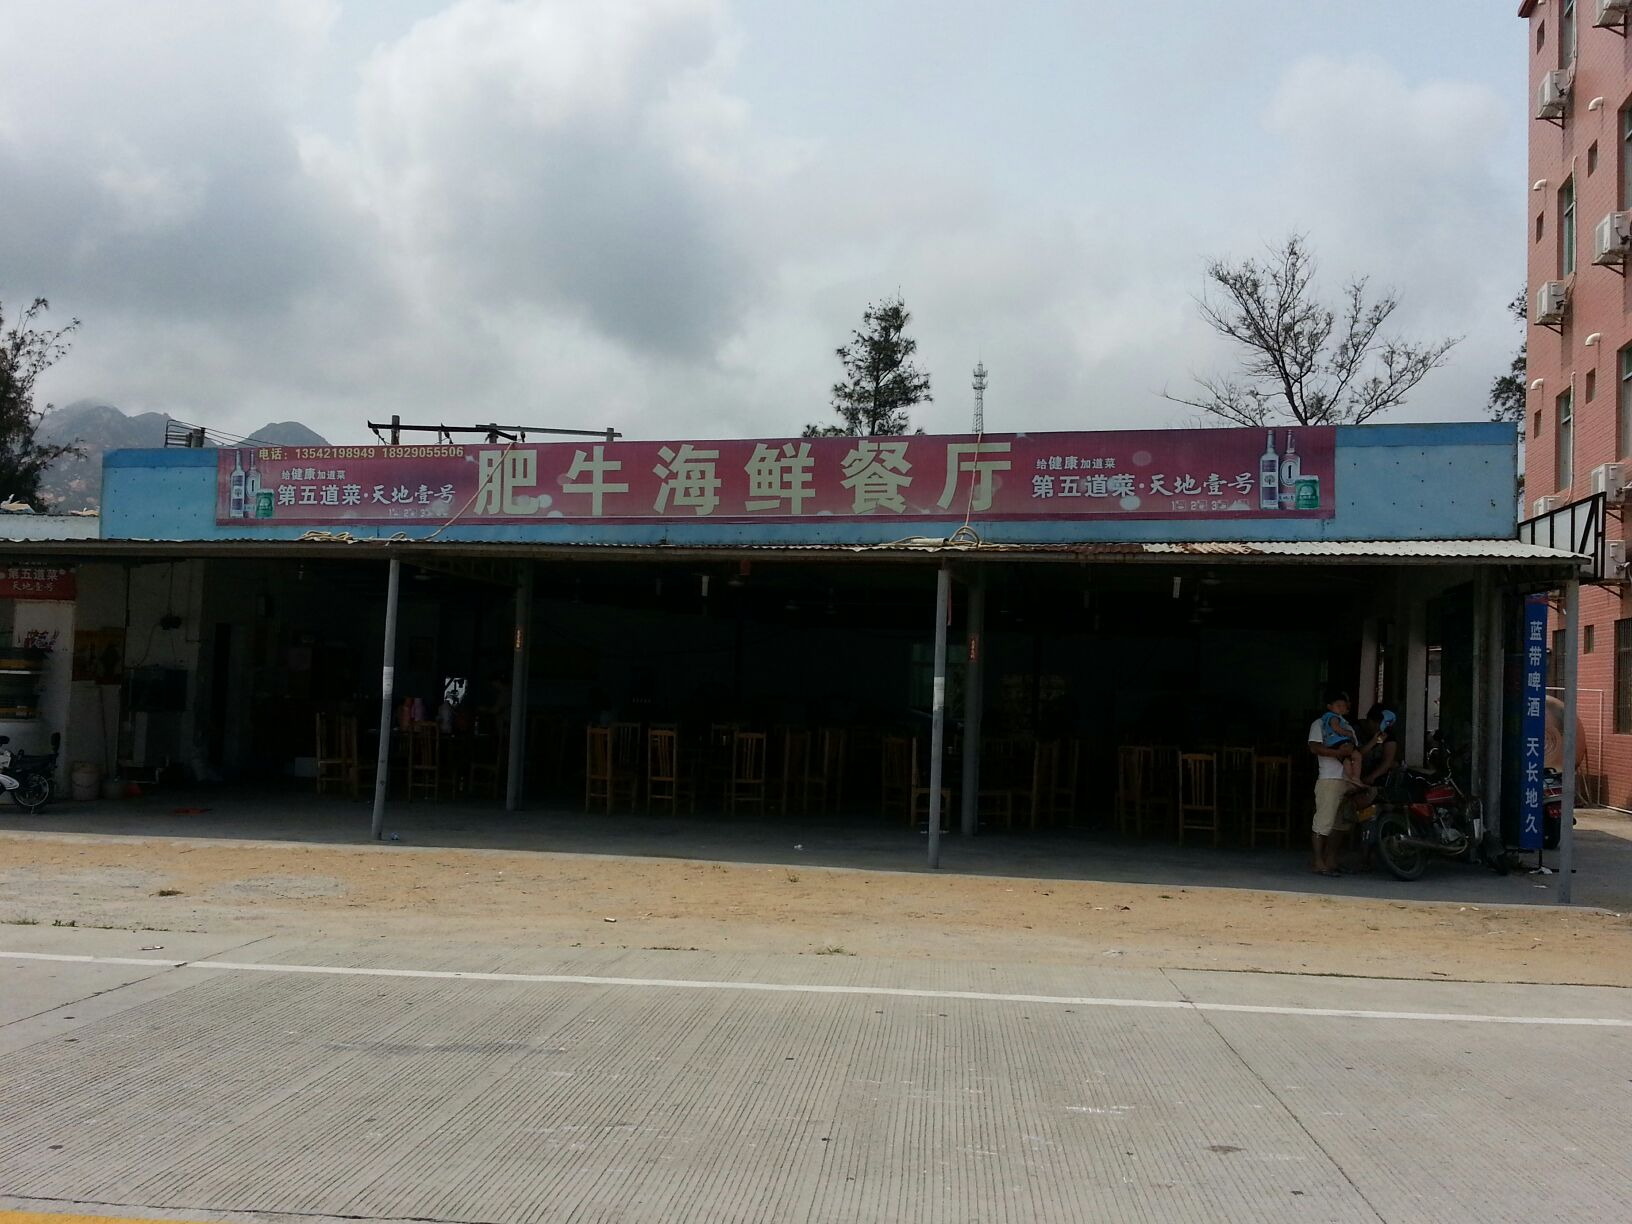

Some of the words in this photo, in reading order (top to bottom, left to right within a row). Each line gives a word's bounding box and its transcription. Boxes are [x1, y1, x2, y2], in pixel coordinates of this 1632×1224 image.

[295, 448, 375, 459] 13542198949
[382, 447, 464, 458] 18929055506
[1036, 456, 1116, 470] 给健康加道菜
[281, 468, 346, 480] 给健康加道菜
[473, 440, 1013, 517] 肥牛海鲜餐厅
[8, 568, 58, 581] 第五道菜
[1527, 620, 1543, 717] 蓝带啤酒
[1525, 737, 1540, 835] 天长地久
